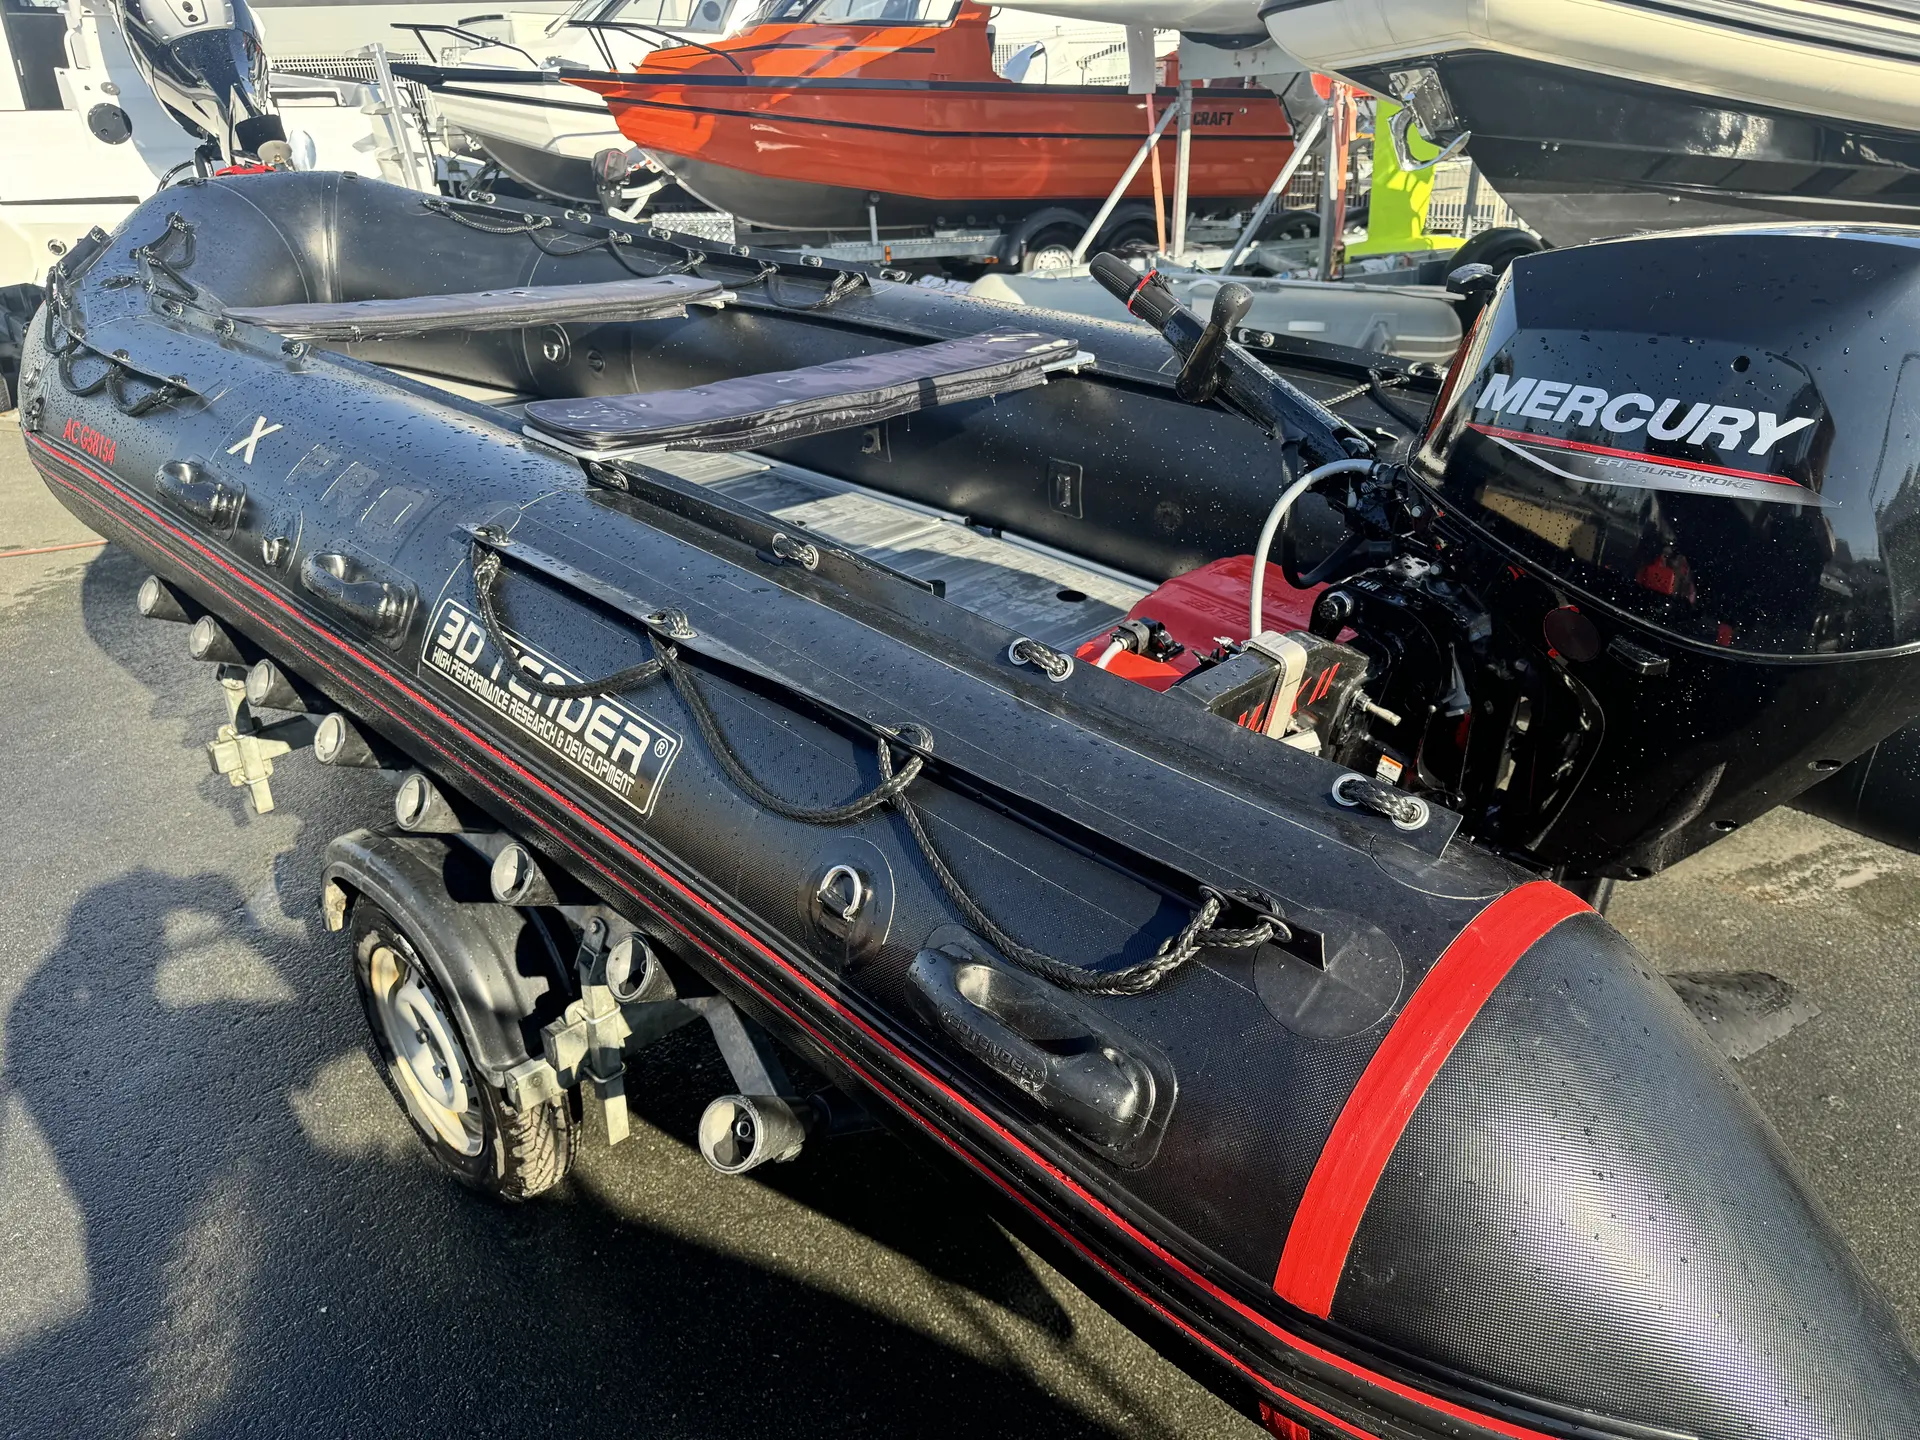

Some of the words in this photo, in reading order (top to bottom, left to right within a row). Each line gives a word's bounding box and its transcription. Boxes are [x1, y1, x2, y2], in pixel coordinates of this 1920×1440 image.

[63, 417, 80, 444] AC
[226, 415, 283, 465] X
[1475, 373, 1815, 455] MERCURY
[437, 610, 486, 664] 3D
[432, 646, 453, 673] HIGH
[450, 658, 510, 712] PERFORMANCE
[508, 695, 558, 743] RESEARCH
[563, 736, 635, 796] DEVELOPMENT
